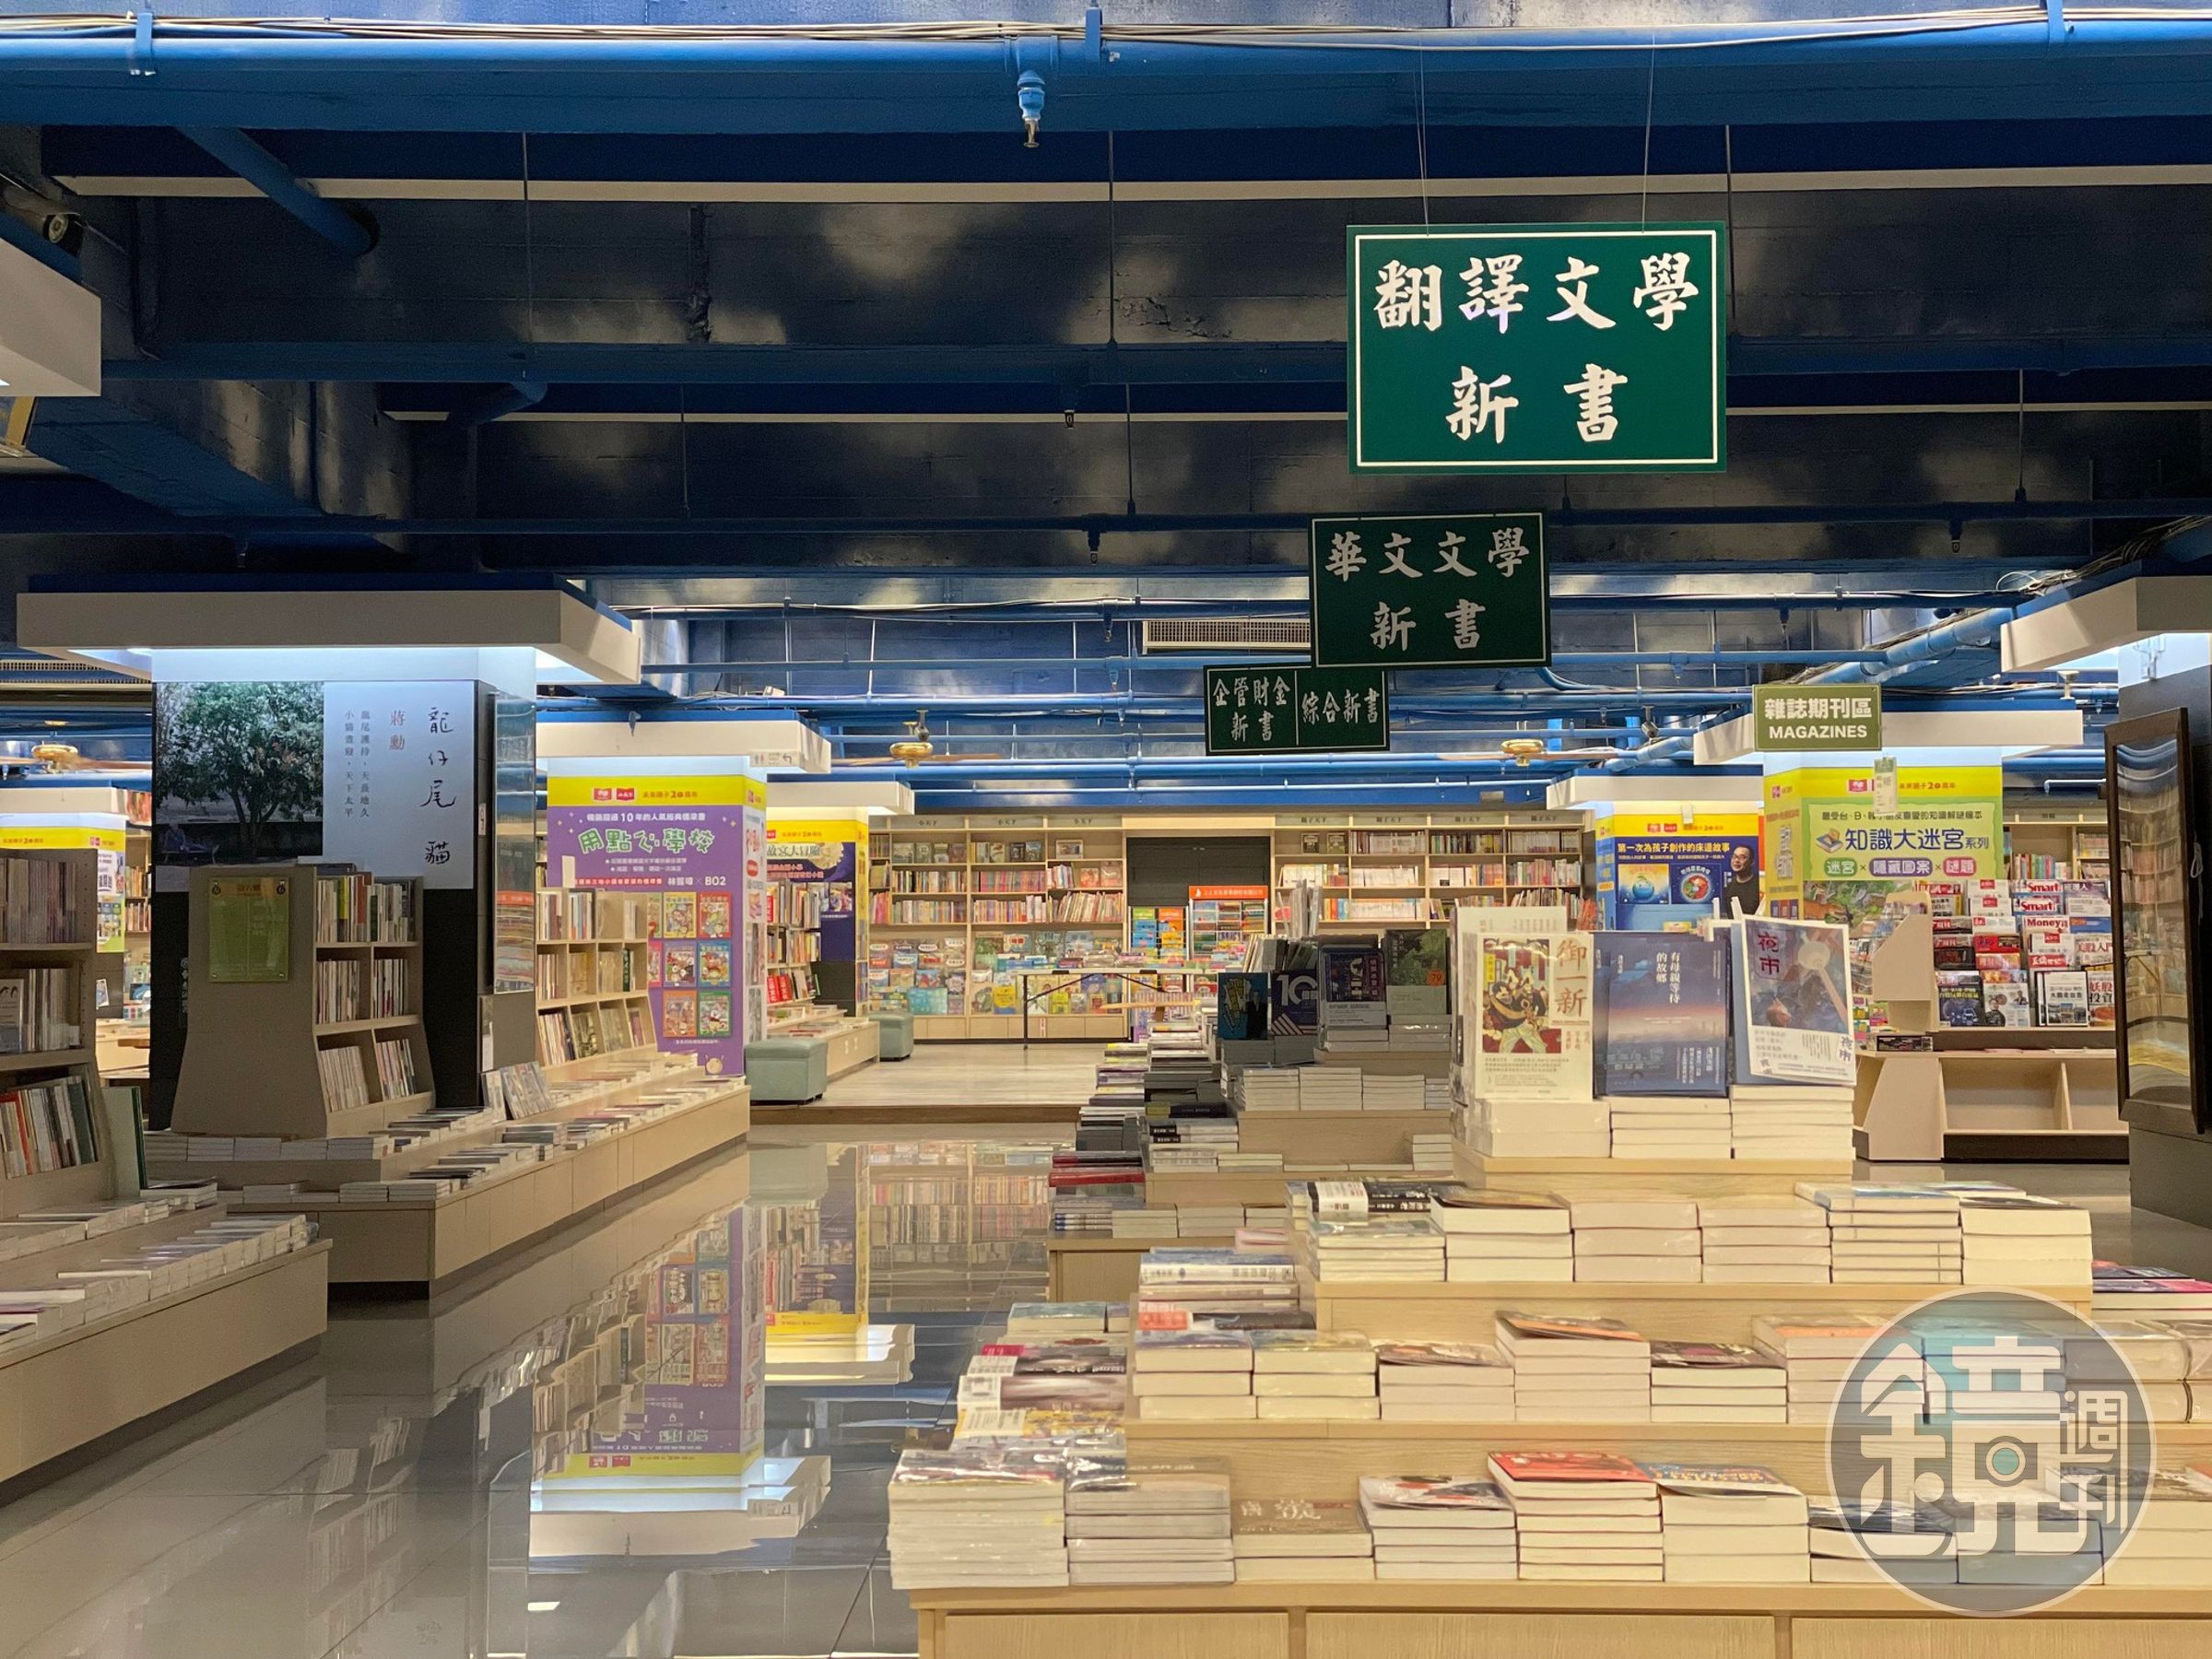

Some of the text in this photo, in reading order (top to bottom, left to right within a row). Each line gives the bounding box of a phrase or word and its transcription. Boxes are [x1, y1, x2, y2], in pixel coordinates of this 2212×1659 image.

[1373, 252, 1699, 334] 翻譯文學
[1446, 364, 1628, 443] 新書
[1324, 527, 1530, 582] 華文文學
[1371, 599, 1486, 651] 新書
[1213, 676, 1290, 707] 企管財金
[1301, 688, 1380, 725] 綜合新書
[1764, 697, 1872, 721] 雜誌期刊區
[1231, 711, 1274, 742] 新書
[1769, 724, 1867, 740] MAGAZINES
[578, 828, 714, 854] 用點心學校
[1845, 828, 1989, 852] 知識大迷宮 系列
[1826, 861, 1854, 874] 迷宮
[2028, 883, 2060, 893] Smart
[2019, 901, 2053, 912] Smart
[1656, 951, 1667, 983] 的故鄉
[1756, 931, 1781, 975] 夜市
[1555, 936, 1588, 1018] 御一新
[1669, 951, 1680, 1004] 有母親等待
